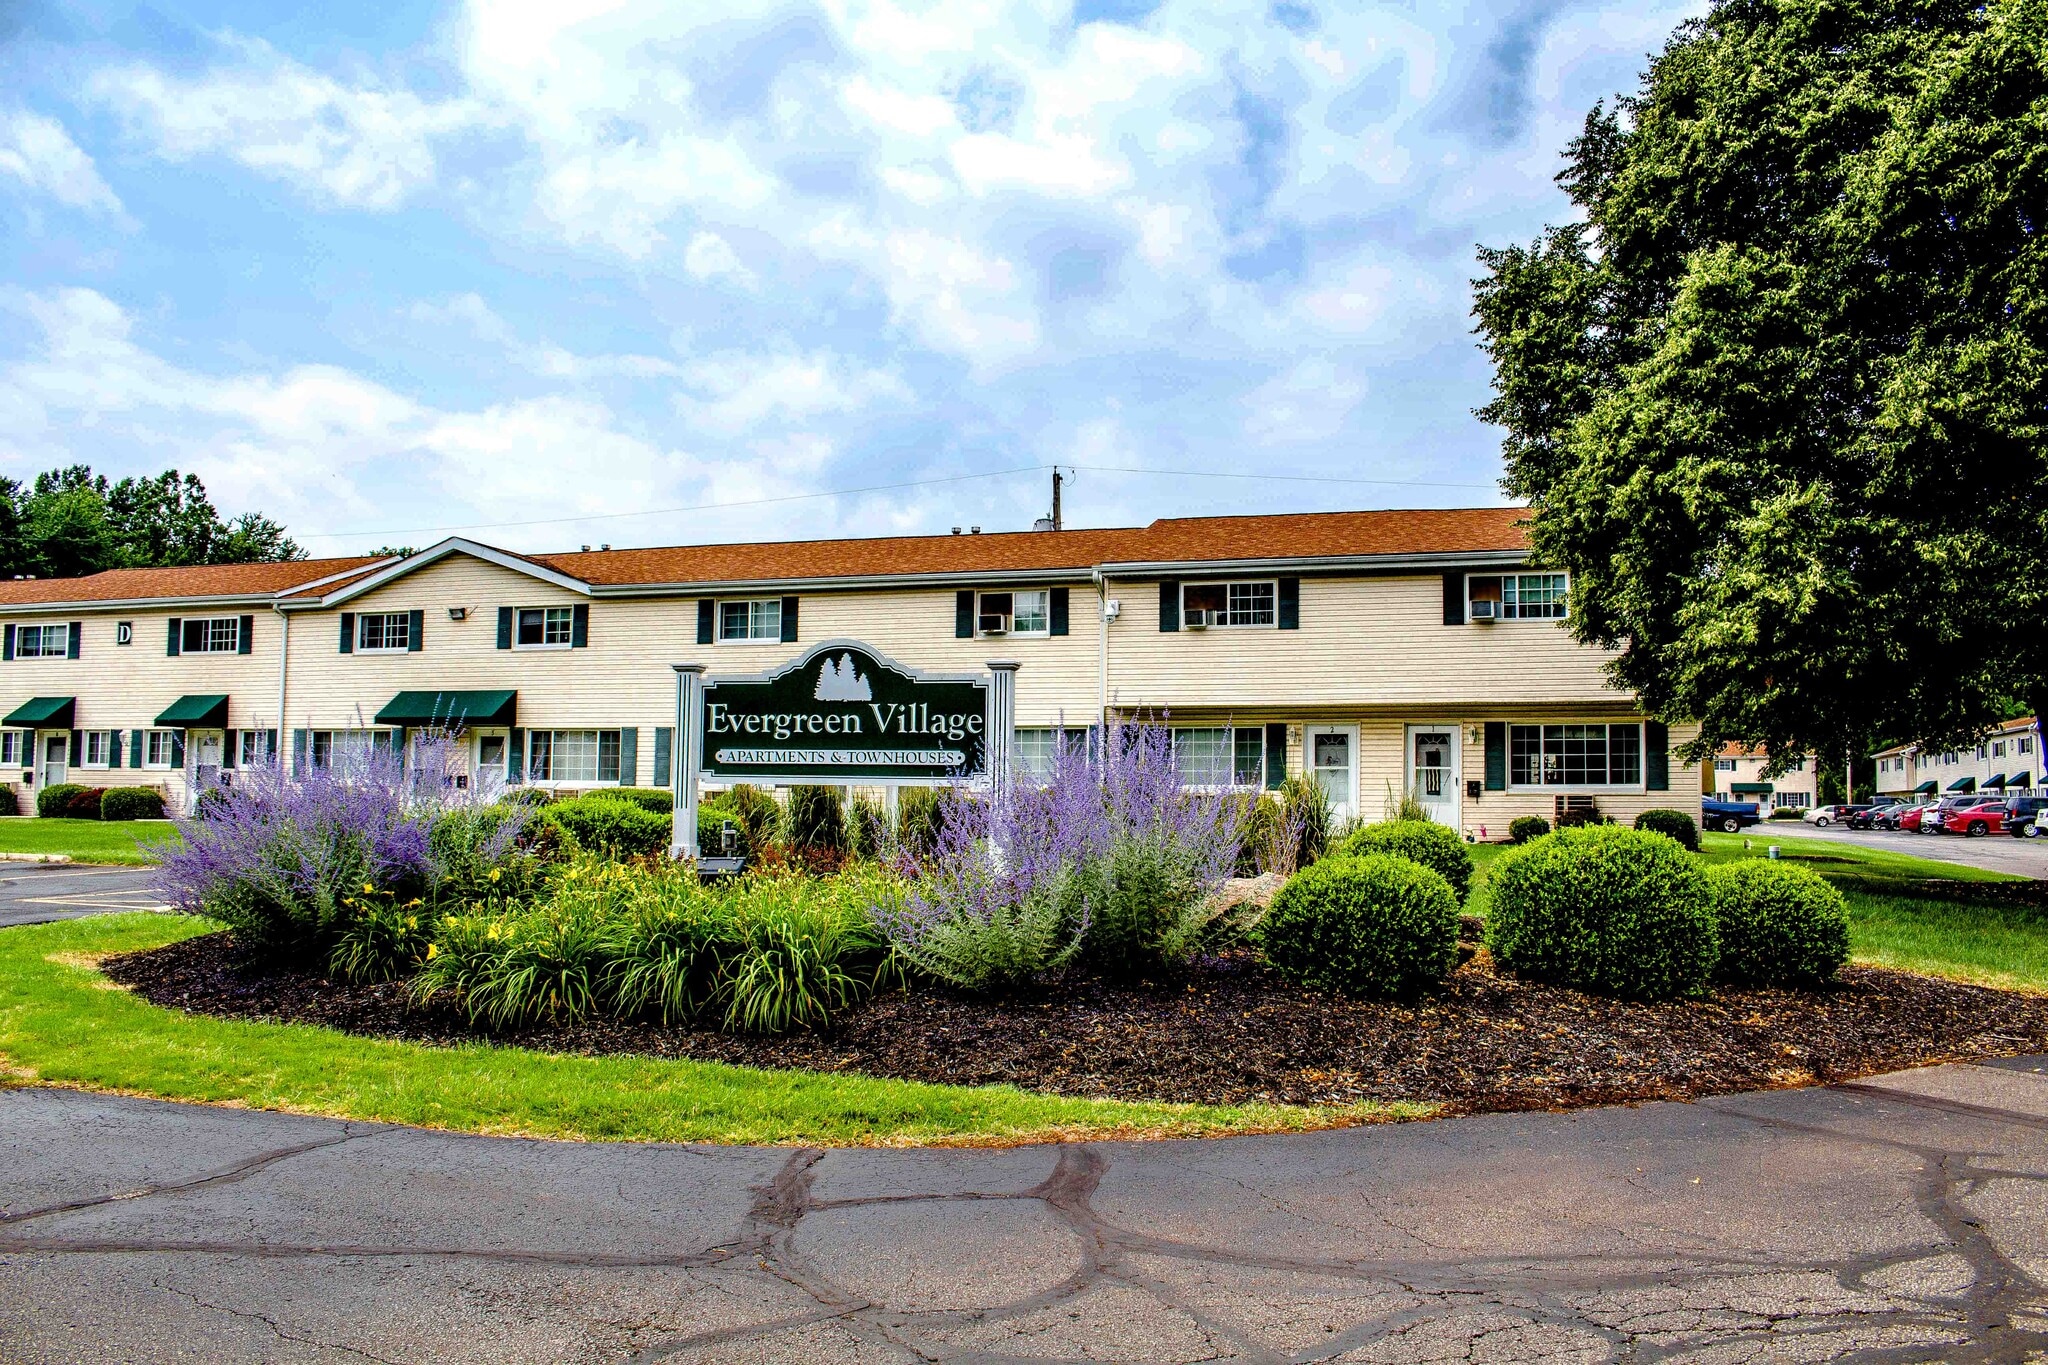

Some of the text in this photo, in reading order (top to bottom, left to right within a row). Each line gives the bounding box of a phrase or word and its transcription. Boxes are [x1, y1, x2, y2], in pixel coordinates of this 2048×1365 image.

[119, 625, 131, 642] D
[707, 702, 983, 740] Evergreen Village
[726, 750, 954, 764] APARTMENTS & TOWNHOUSES
